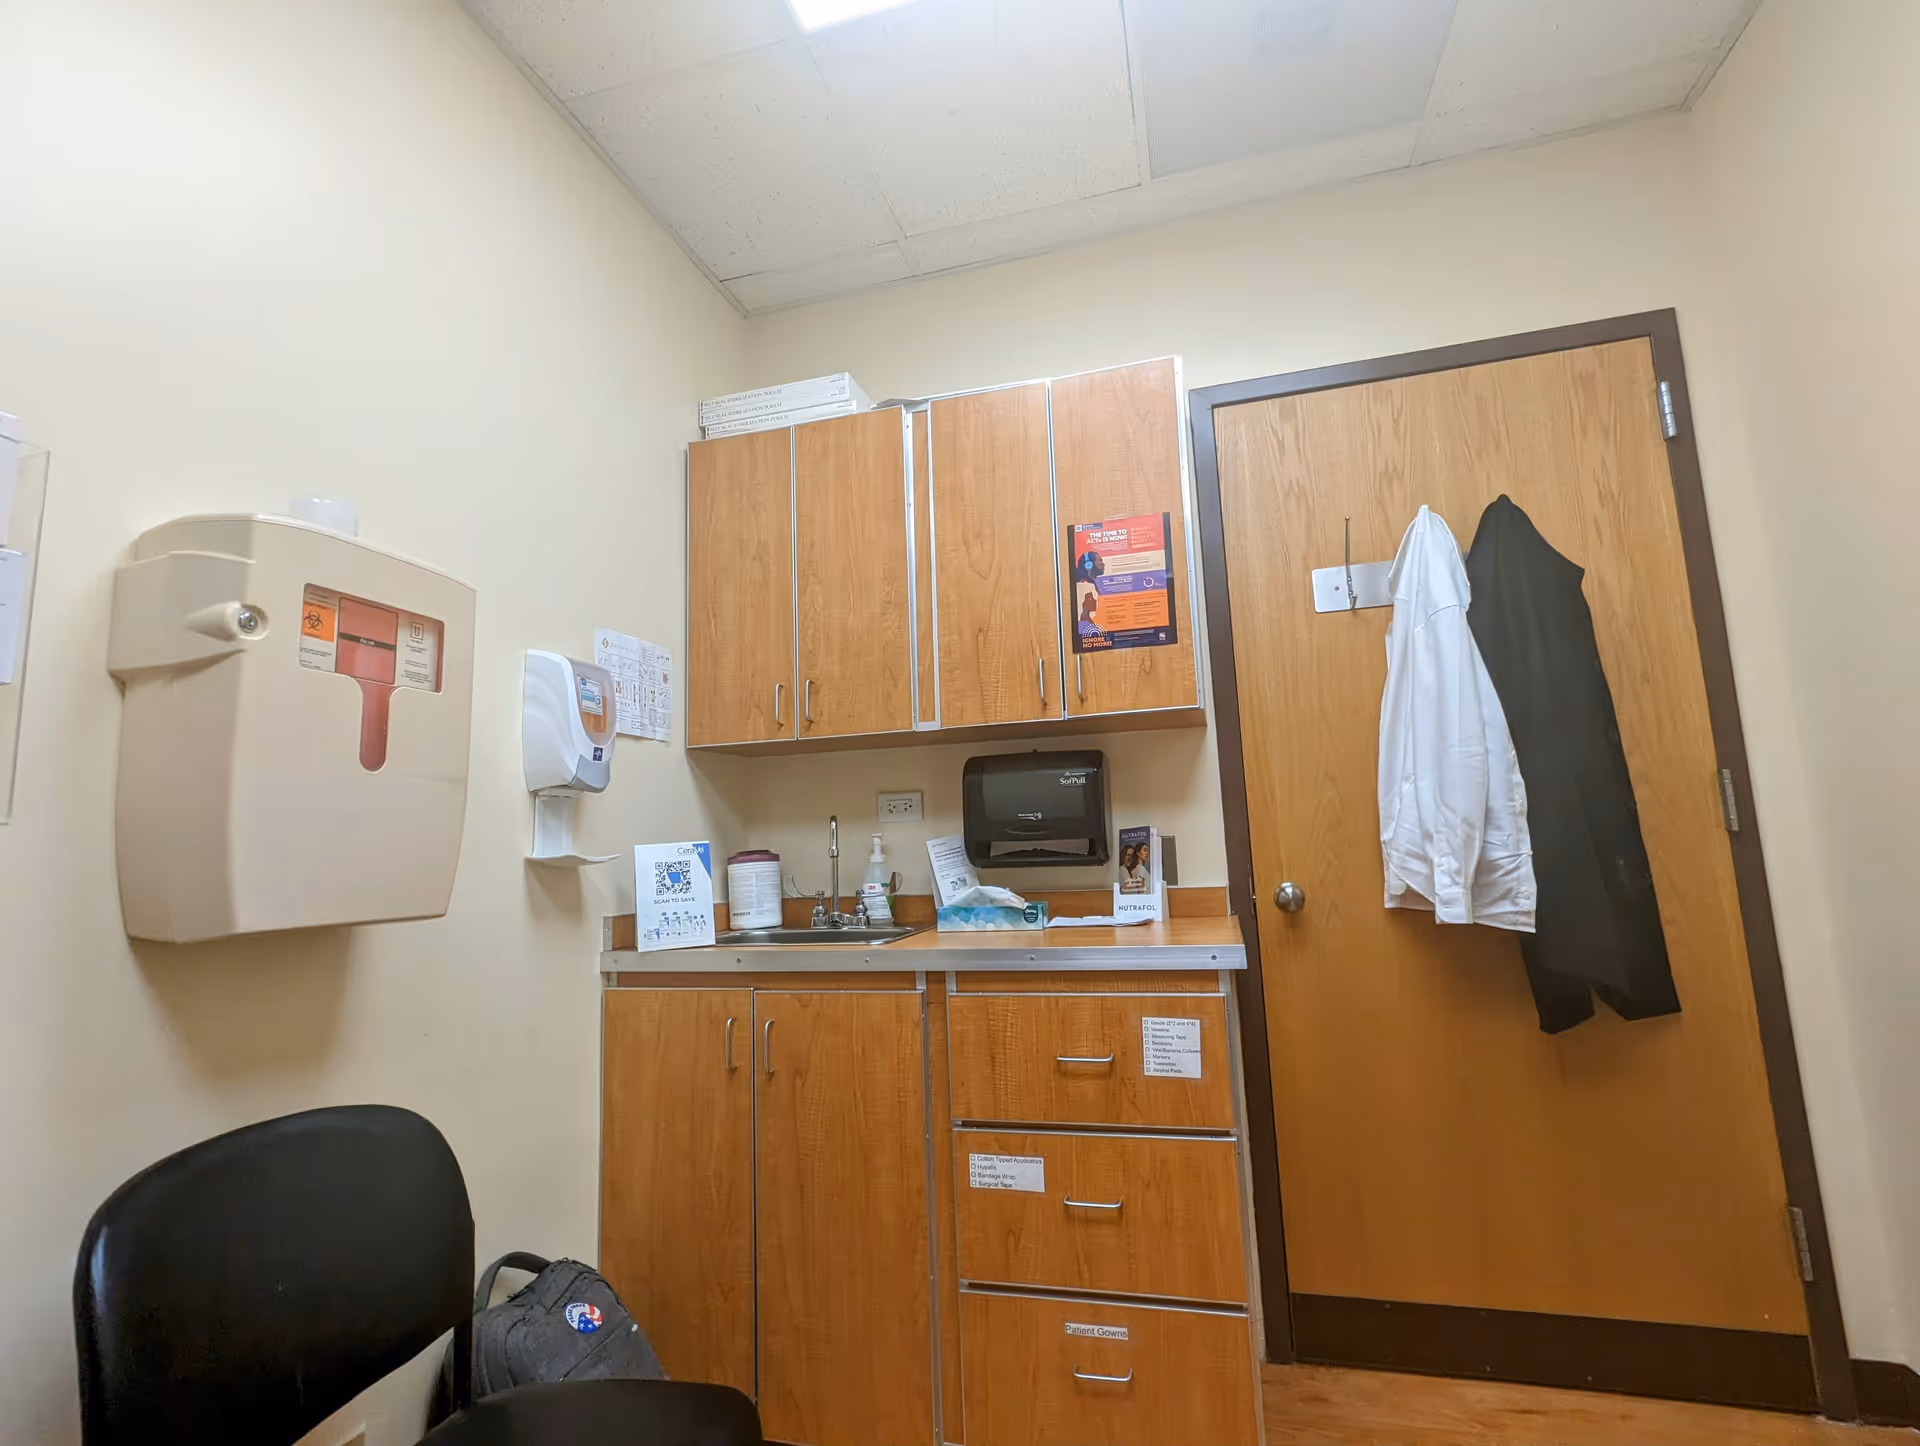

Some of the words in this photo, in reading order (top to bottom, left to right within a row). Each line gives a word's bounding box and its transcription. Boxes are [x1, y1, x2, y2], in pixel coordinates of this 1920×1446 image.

[727, 393, 762, 403] STERILIZATION
[728, 405, 763, 416] STERILIZATION
[1060, 776, 1086, 785] SofPull
[677, 846, 704, 855] CeraVe
[1119, 904, 1157, 912] NUTRAFOL
[978, 1172, 1001, 1180] Bandage
[1065, 1324, 1095, 1335] Patient
[1097, 1327, 1128, 1338] Gowns
